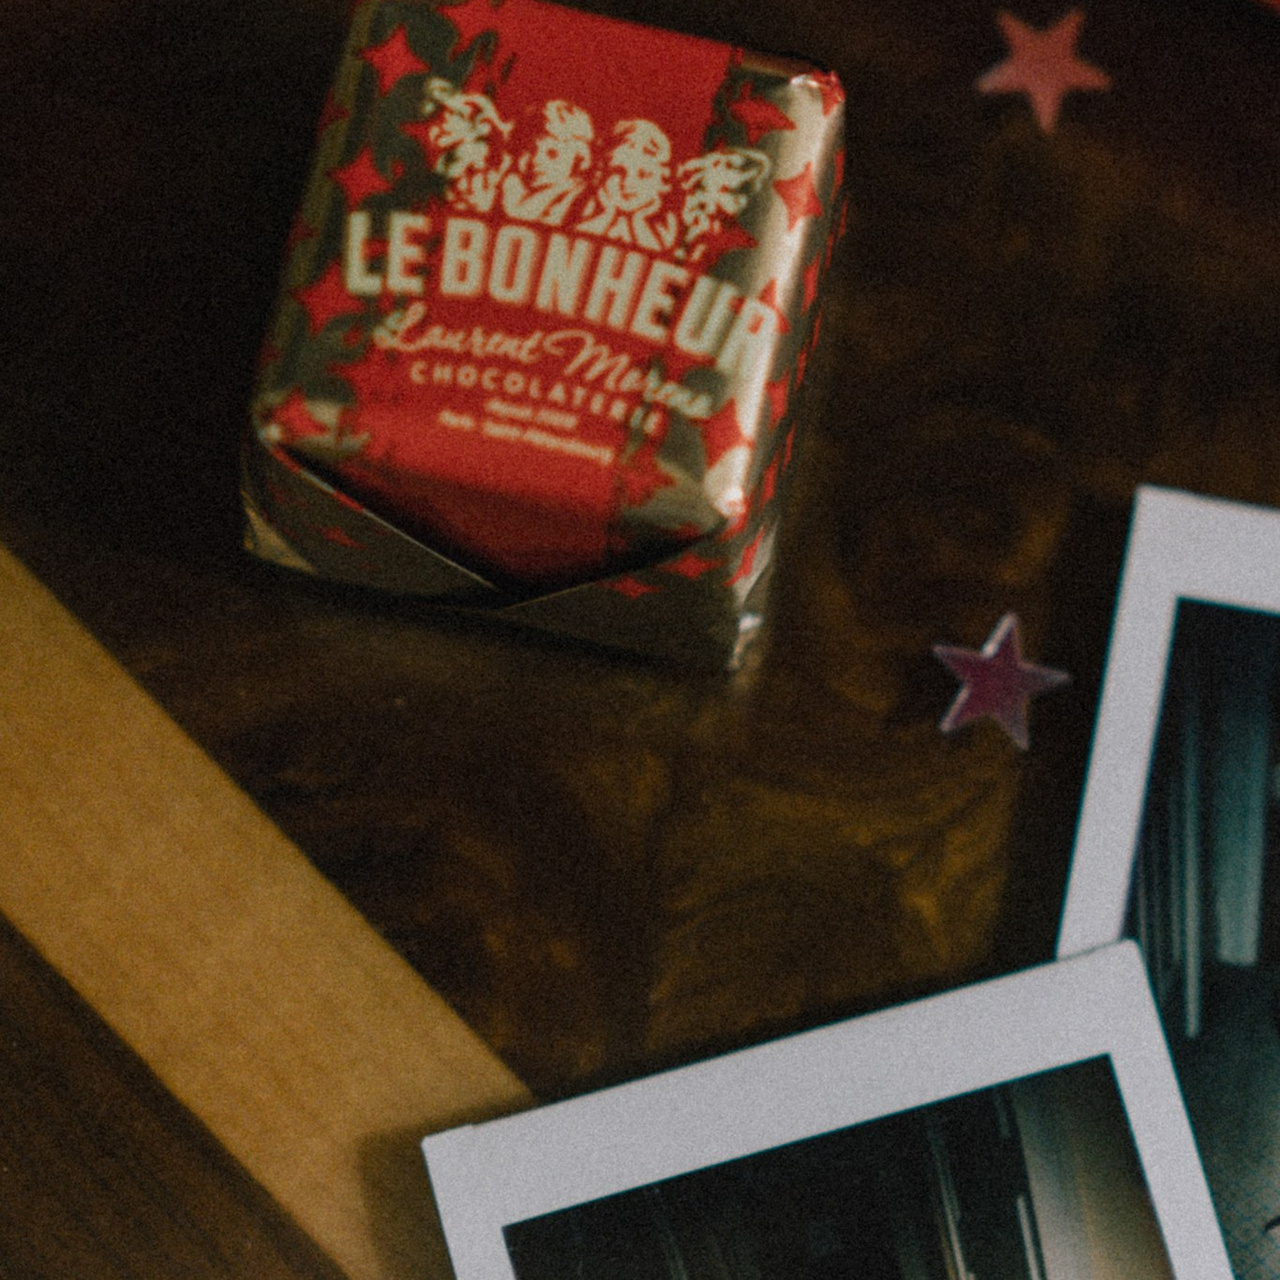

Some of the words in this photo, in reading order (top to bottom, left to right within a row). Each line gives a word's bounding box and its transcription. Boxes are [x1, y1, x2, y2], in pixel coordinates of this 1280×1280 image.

[344, 210, 432, 296] LE
[440, 218, 780, 374] BONHEUR
[373, 302, 540, 361] Laurent
[410, 360, 662, 435] CHOCOLATERIE
